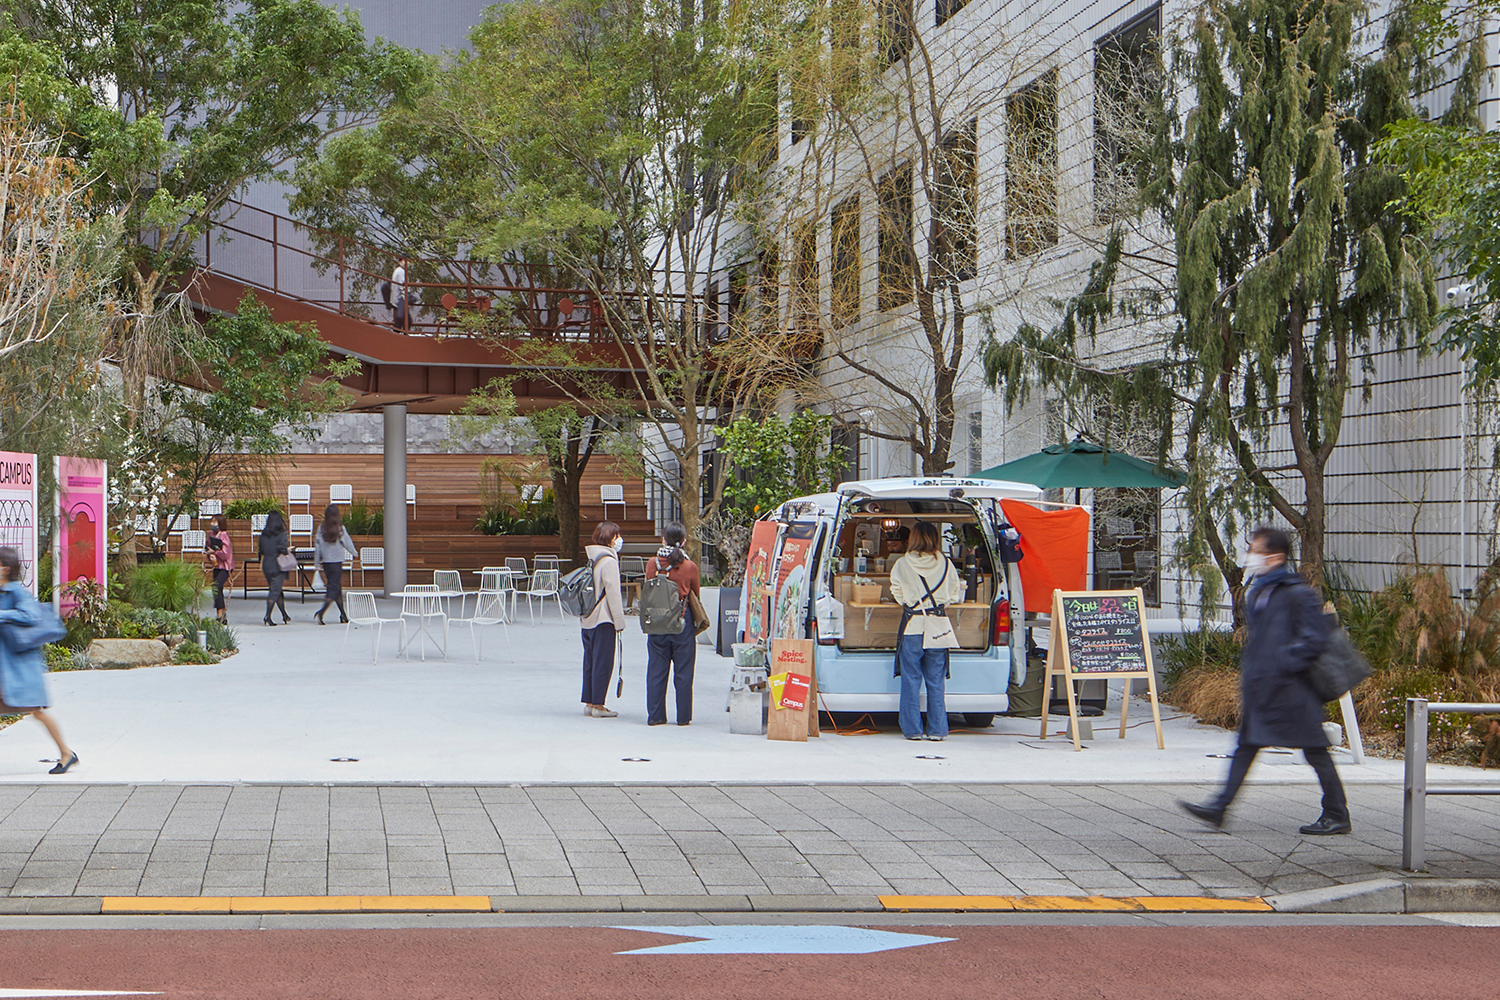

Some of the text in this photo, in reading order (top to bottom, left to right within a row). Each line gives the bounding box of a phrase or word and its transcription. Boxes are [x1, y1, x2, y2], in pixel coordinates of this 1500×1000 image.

[0, 461, 32, 485] CAMPUS
[1069, 599, 1099, 613] 今日は
[781, 650, 804, 658] Spice
